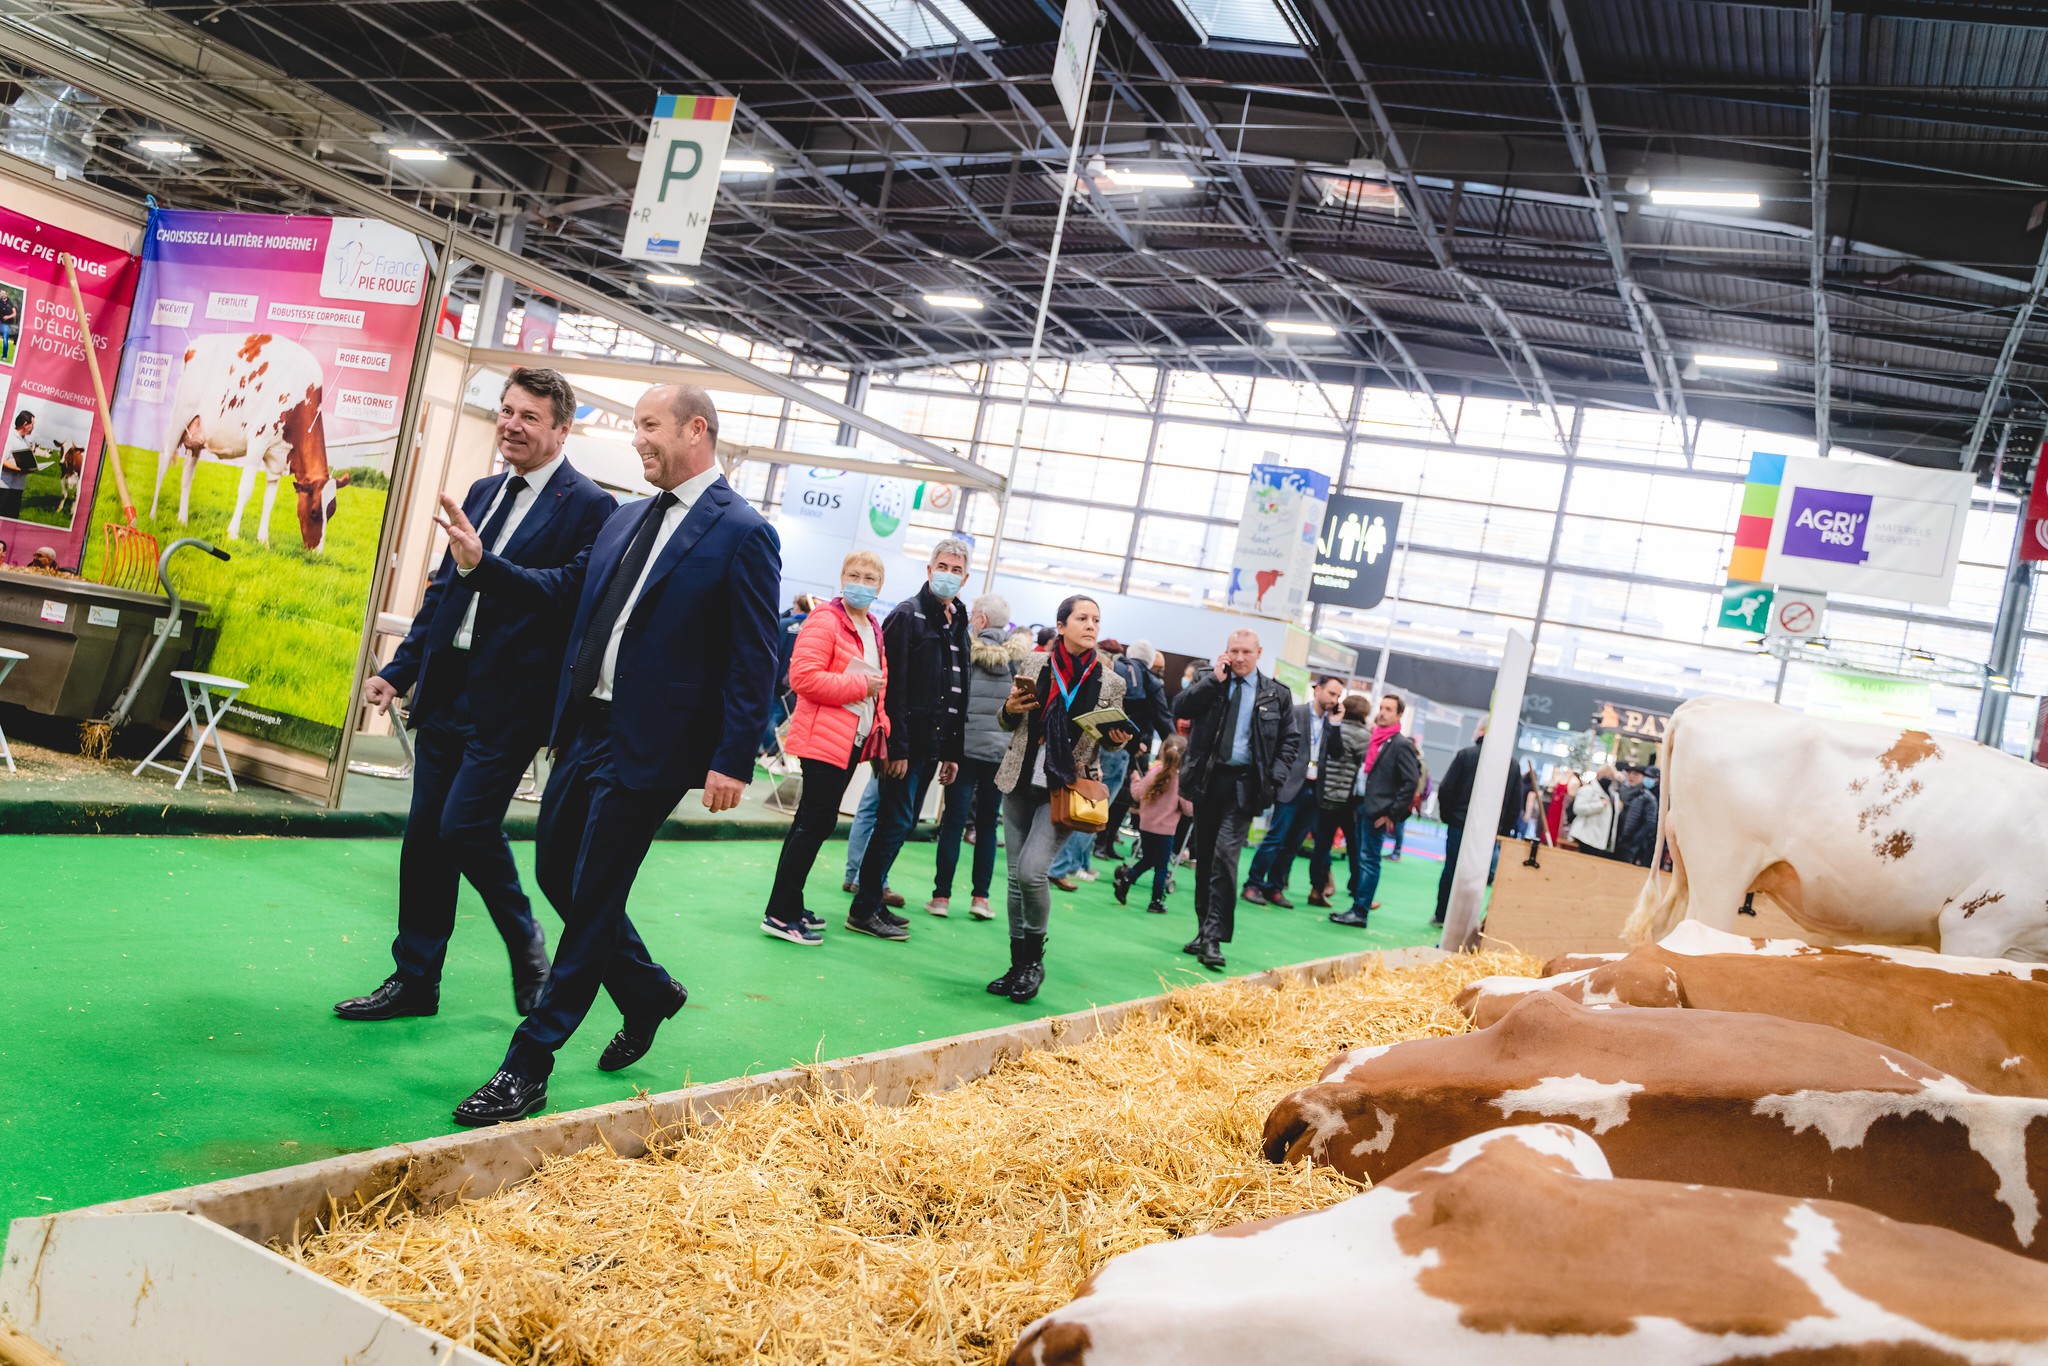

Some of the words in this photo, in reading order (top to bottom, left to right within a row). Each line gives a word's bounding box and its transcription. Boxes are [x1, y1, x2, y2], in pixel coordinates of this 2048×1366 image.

[657, 139, 703, 203] P
[640, 208, 652, 223] R
[686, 212, 699, 228] N
[156, 229, 209, 245] CHOISISSEZ
[210, 233, 221, 246] LA
[223, 232, 263, 248] LAITIÈRE
[32, 244, 55, 261] PIE
[375, 255, 421, 277] France
[358, 276, 376, 291] PIE
[378, 278, 417, 294] ROUGE
[217, 297, 248, 308] FERTILITÉ
[271, 307, 315, 320] ROBUSTESSE
[316, 311, 361, 325] CORPORELLE
[30, 334, 87, 362] MOTIVÉS
[340, 353, 360, 364] ROBE
[361, 355, 387, 368] ROUGE
[21, 380, 96, 406] ACCOMPAGNEMENT
[342, 394, 361, 406] SANS
[363, 396, 393, 409] CORNES
[803, 490, 842, 509] GDS
[1821, 530, 1854, 546] PRO
